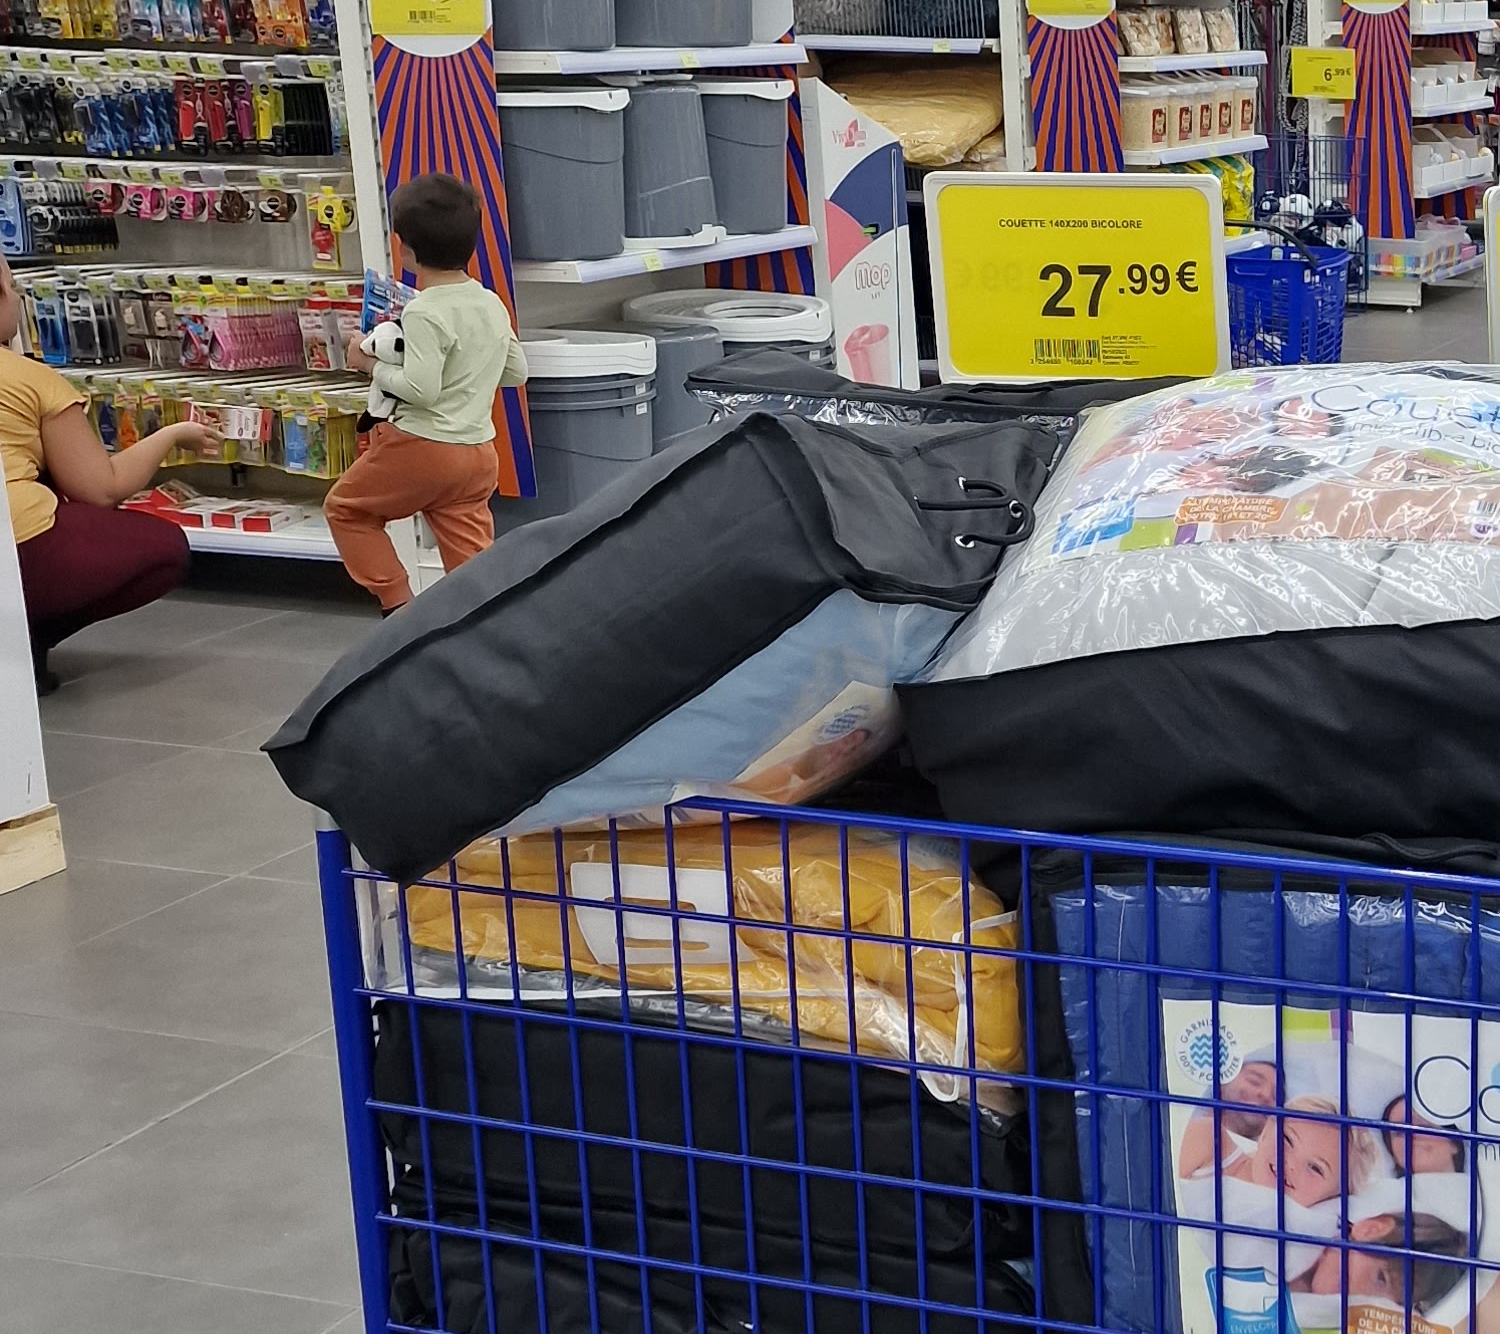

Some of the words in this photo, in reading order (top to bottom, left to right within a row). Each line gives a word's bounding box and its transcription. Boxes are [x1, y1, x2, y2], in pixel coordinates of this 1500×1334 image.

[999, 219, 1046, 228] COUETTE
[1049, 220, 1088, 228] 140X200
[1091, 220, 1143, 229] BICOLORE
[855, 261, 891, 290] Mop
[1039, 261, 1199, 317] 27.99€
[1180, 1019, 1237, 1046] GARNIAGE
[1199, 1056, 1240, 1081] POYESTER
[1359, 1317, 1373, 1329] DE
[1376, 1322, 1388, 1334] LA
